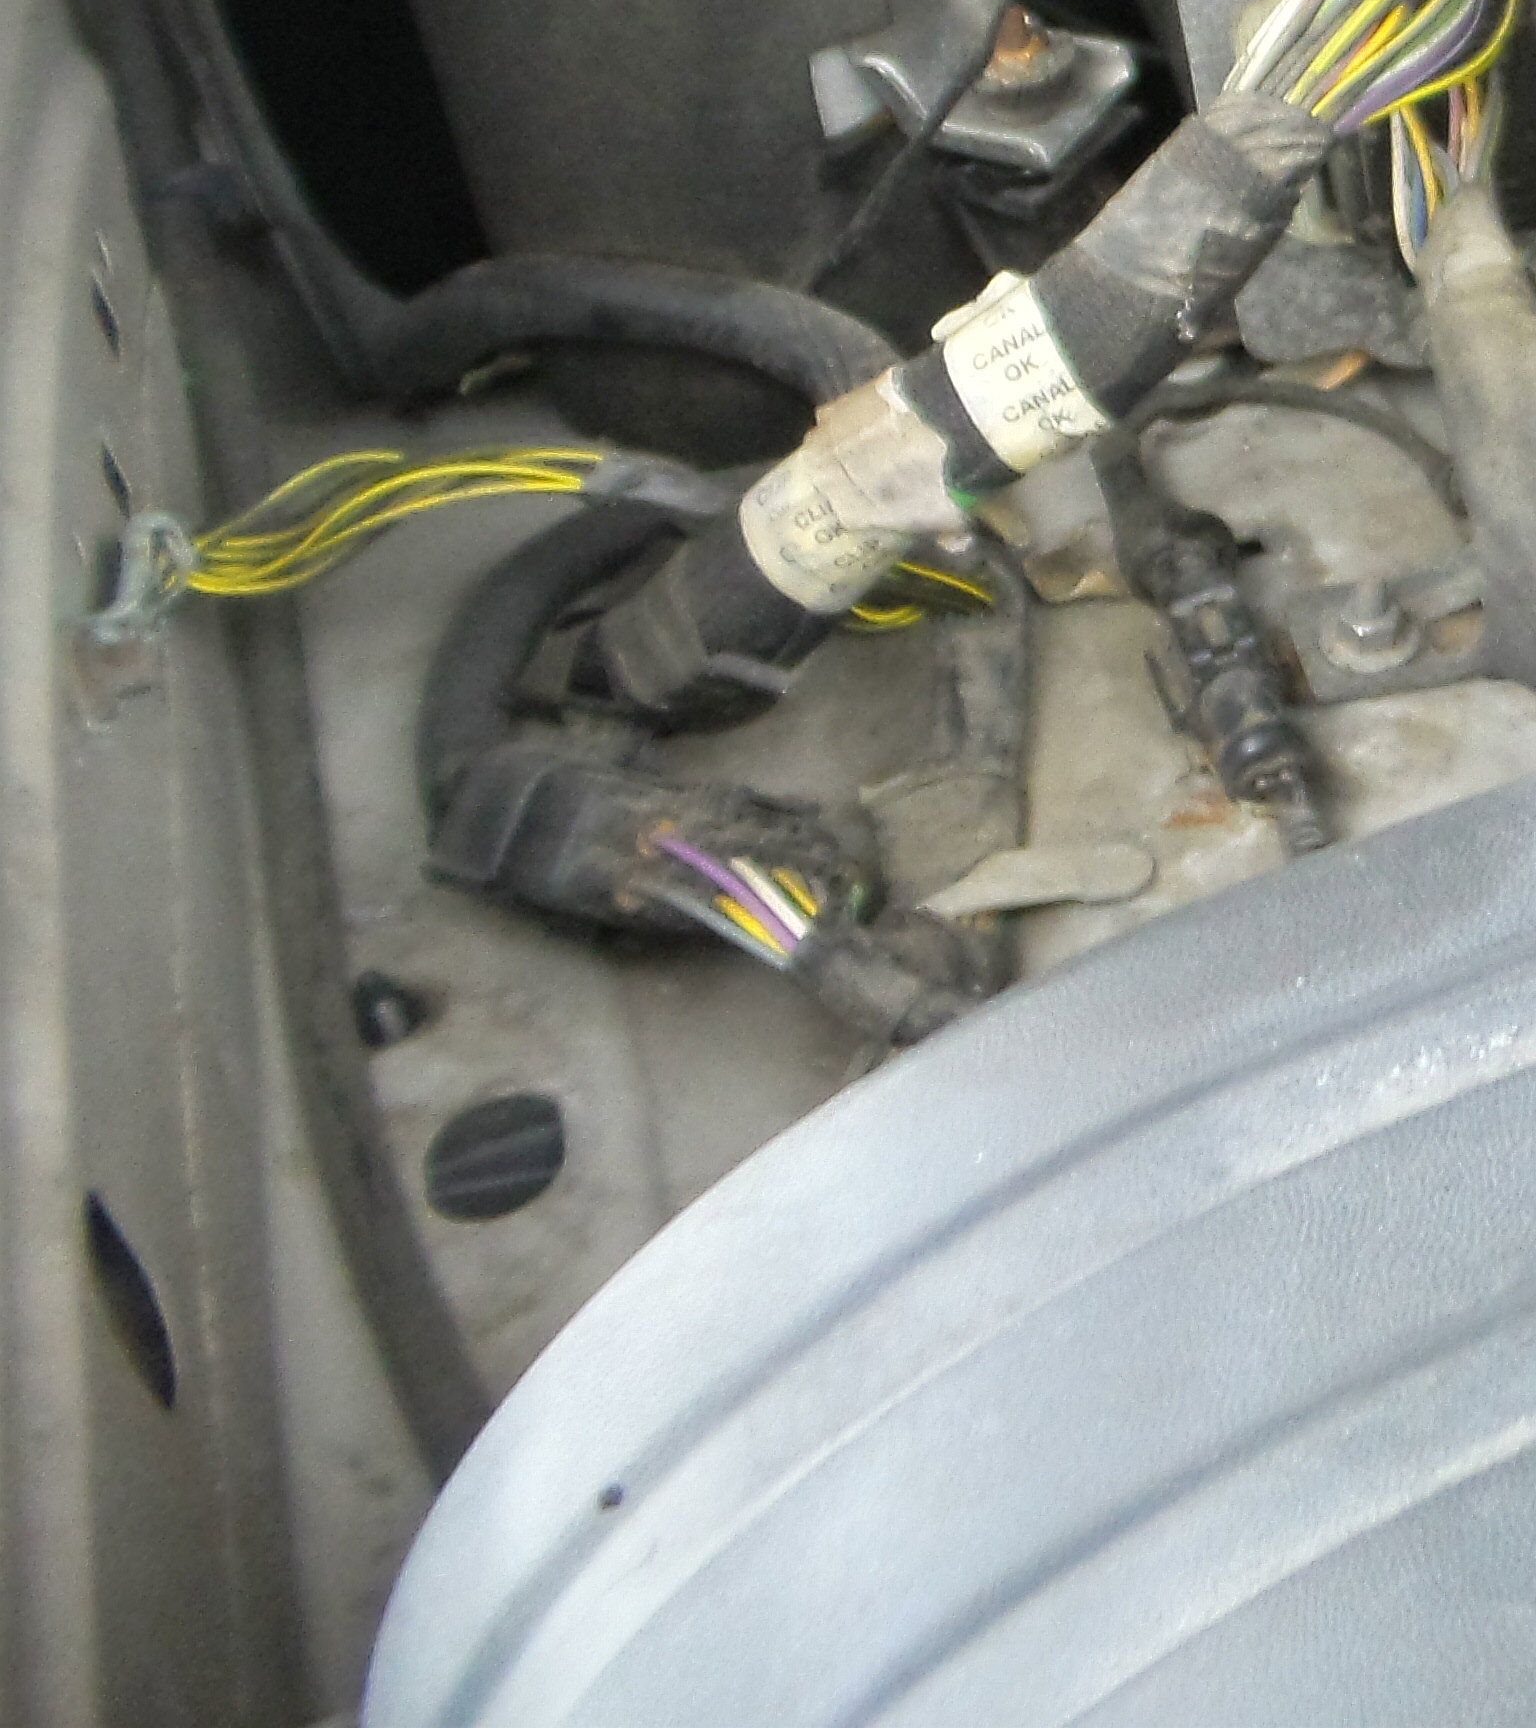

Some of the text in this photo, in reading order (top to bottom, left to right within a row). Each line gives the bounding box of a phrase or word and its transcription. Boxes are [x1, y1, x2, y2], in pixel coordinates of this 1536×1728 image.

[973, 323, 1045, 370] CANAL
[1003, 352, 1040, 382] OK
[1002, 375, 1077, 423] CANAL
